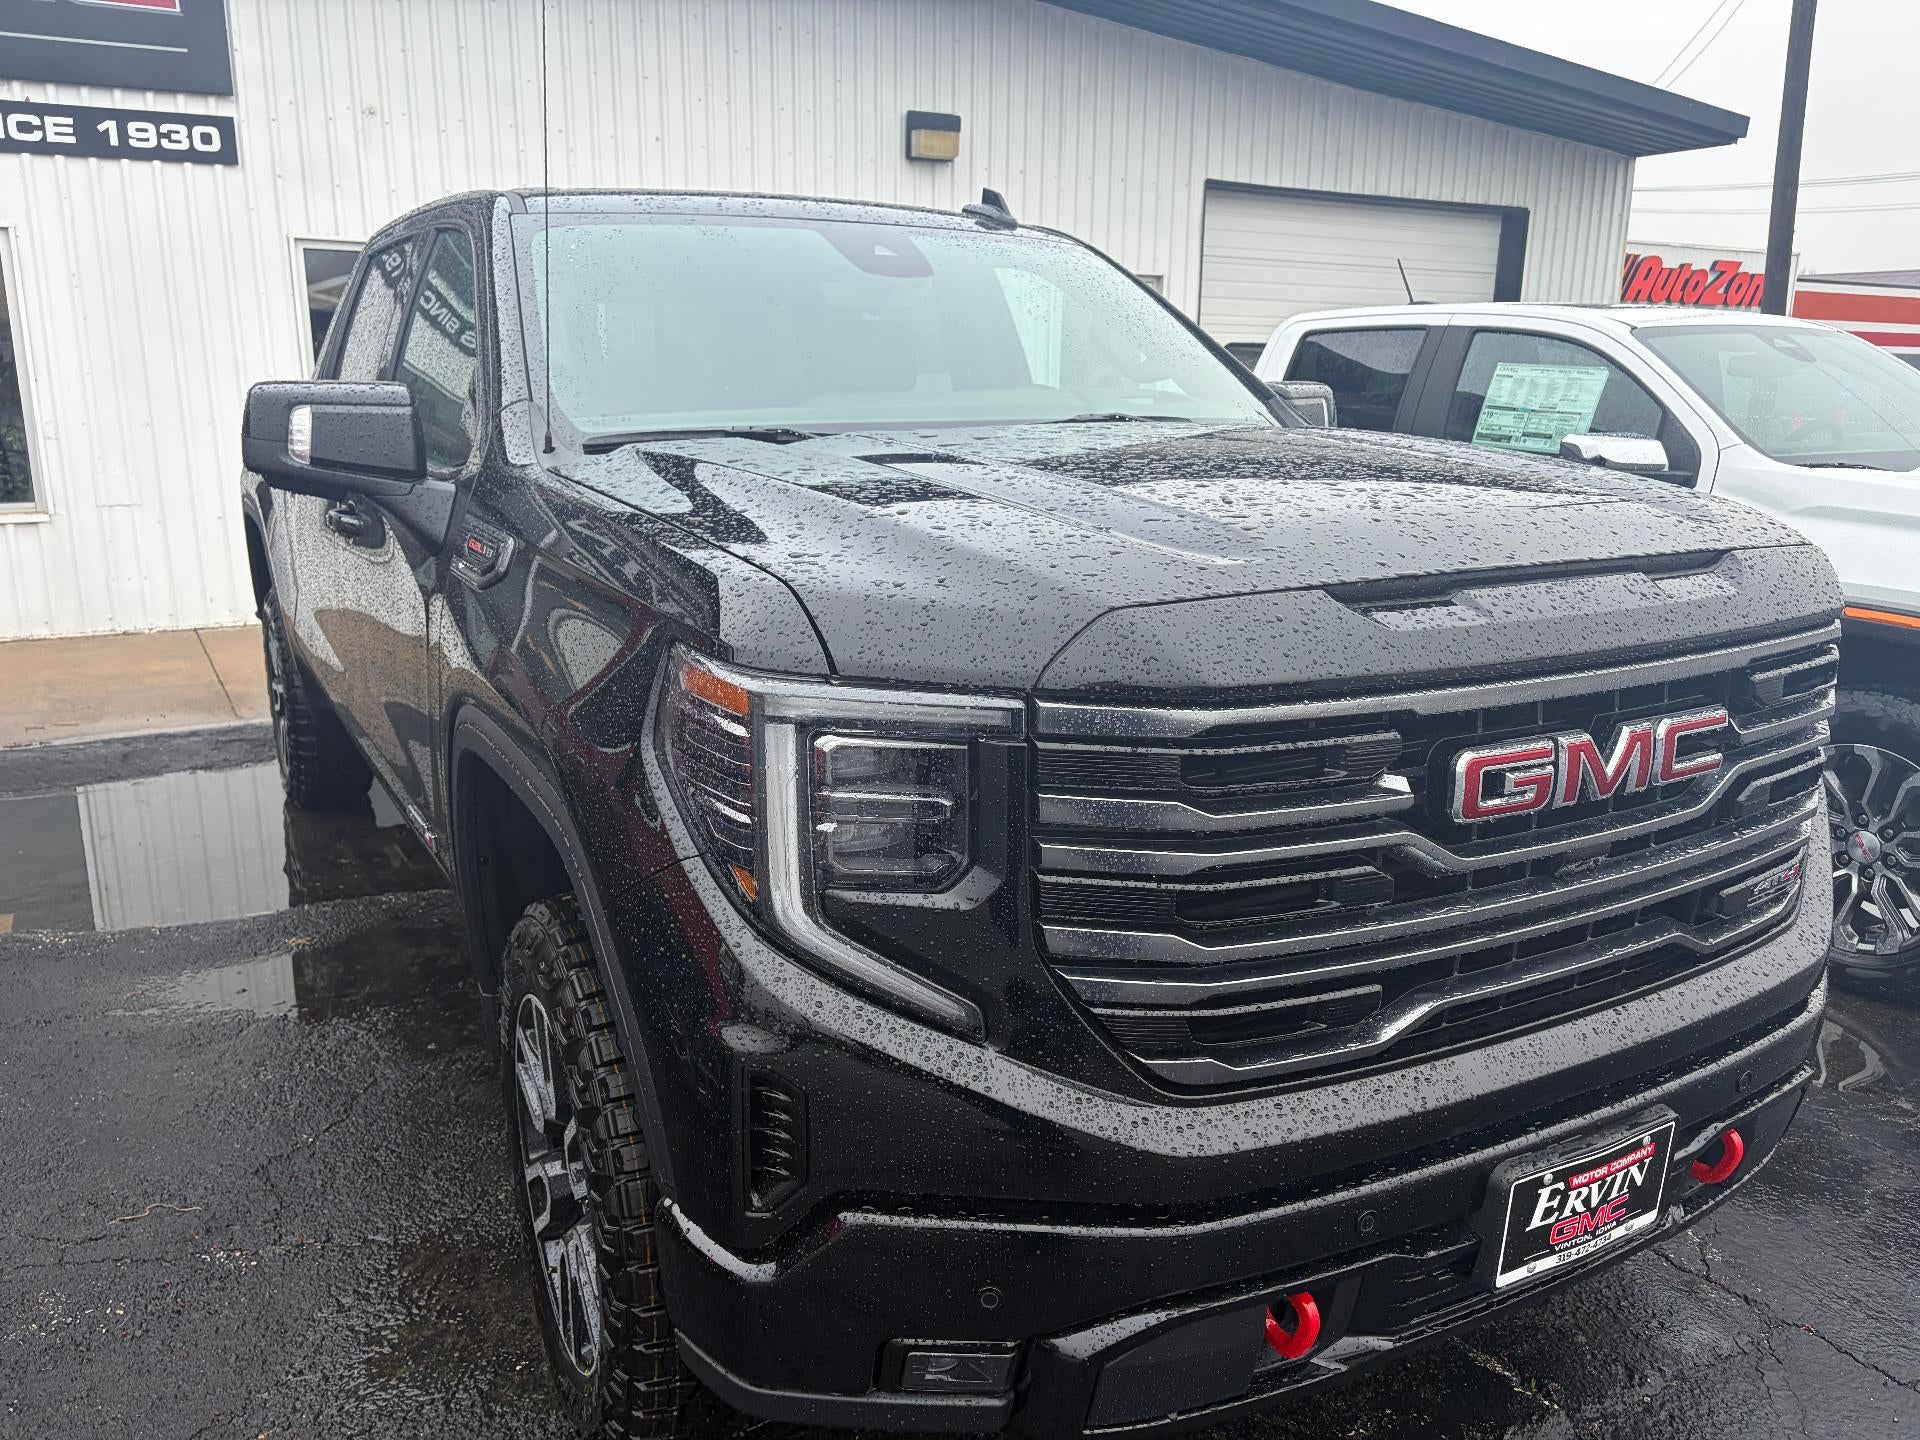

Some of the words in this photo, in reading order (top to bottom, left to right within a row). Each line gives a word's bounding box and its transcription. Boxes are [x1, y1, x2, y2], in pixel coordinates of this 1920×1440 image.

[0, 113, 77, 144] CE
[96, 120, 222, 153] 1930
[1622, 254, 1766, 307] AutoZon
[1452, 704, 1729, 824] GMC
[1572, 1167, 1608, 1187] MOTOR
[1610, 1144, 1655, 1172] COMPANY
[1525, 1157, 1653, 1232] ERVIN
[1550, 1194, 1629, 1244] GMC
[1554, 1233, 1593, 1252] VINTON,
[1595, 1220, 1617, 1236] IOWA
